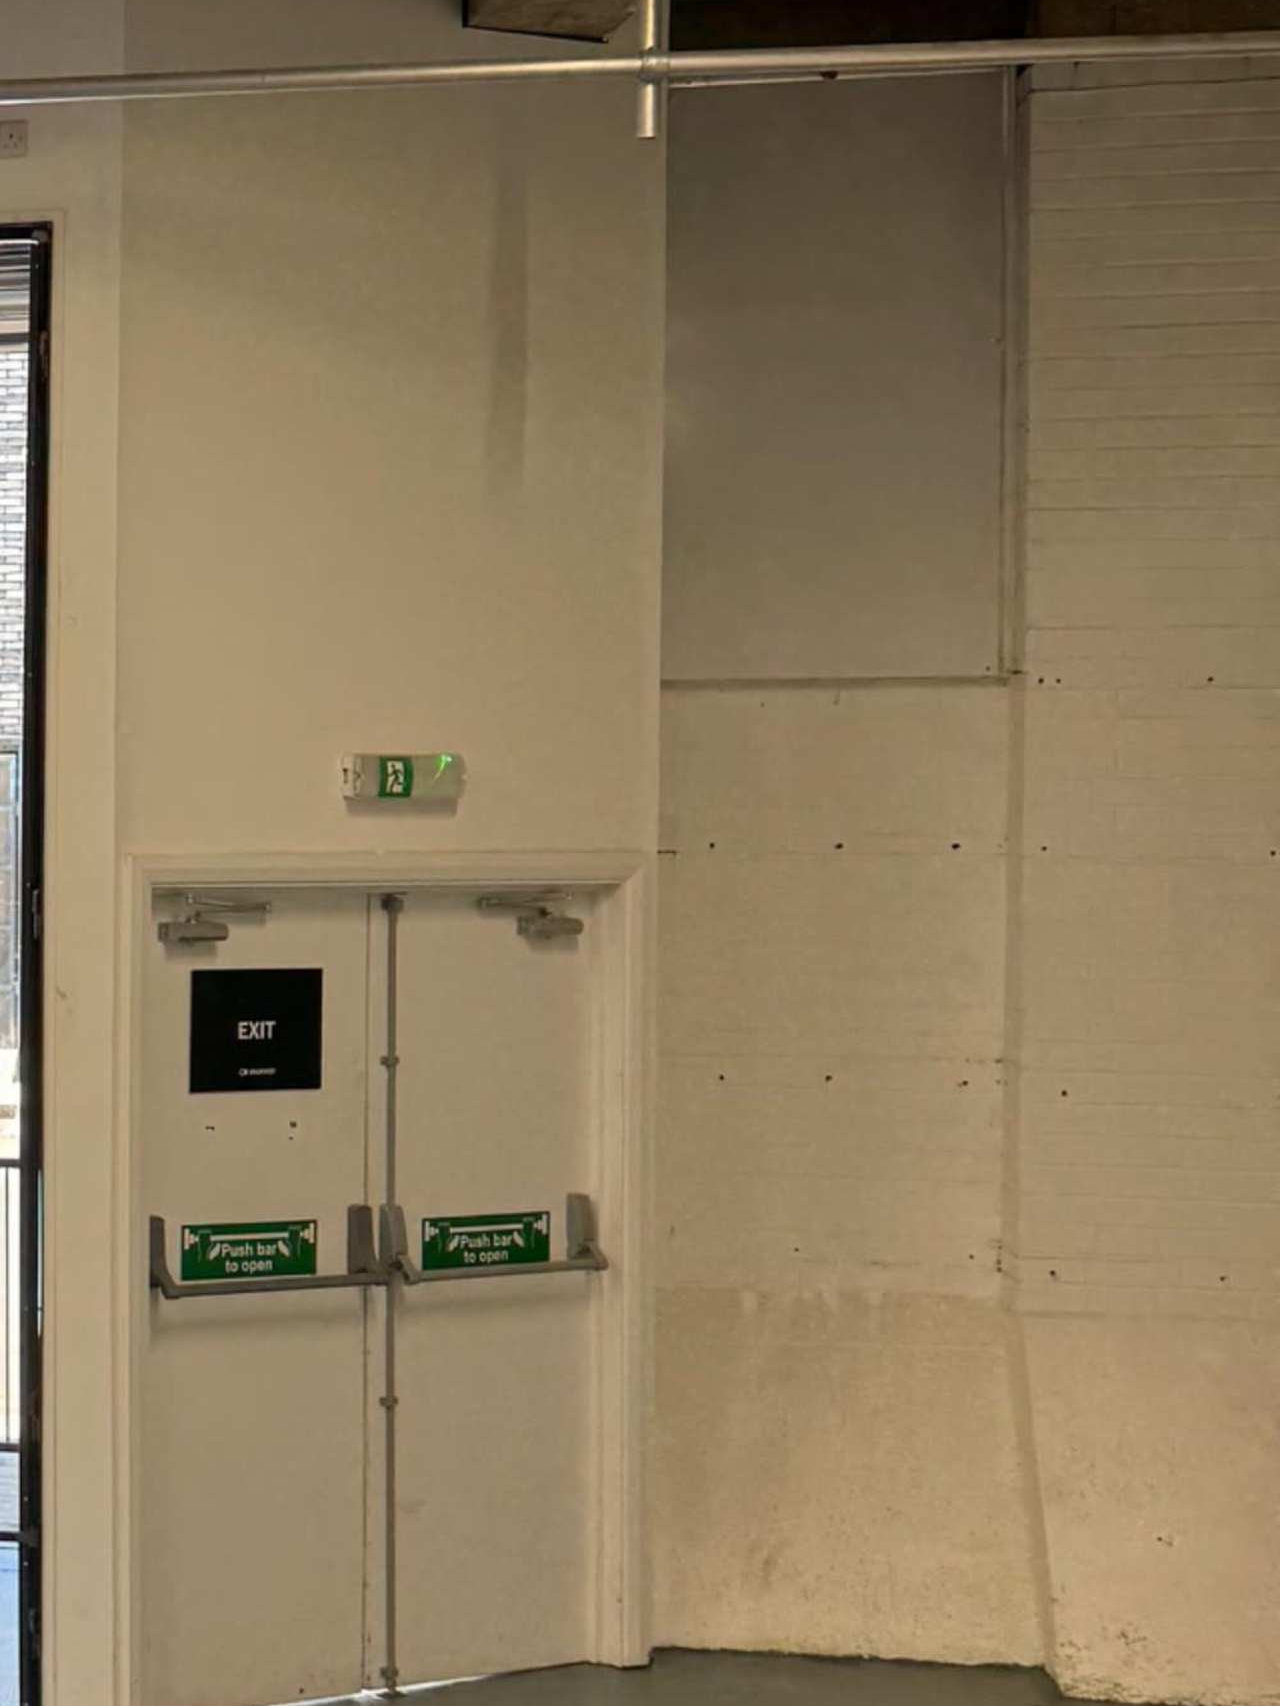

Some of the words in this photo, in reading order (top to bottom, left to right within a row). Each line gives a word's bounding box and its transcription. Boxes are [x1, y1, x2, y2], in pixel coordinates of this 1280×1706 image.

[237, 1020, 277, 1040] EXIT
[460, 1233, 490, 1249] Push
[493, 1233, 512, 1246] bar
[221, 1242, 253, 1258] Push
[257, 1242, 277, 1256] bar
[464, 1251, 476, 1263] to
[479, 1250, 509, 1264] open
[225, 1260, 238, 1273] to
[241, 1259, 273, 1274] open
